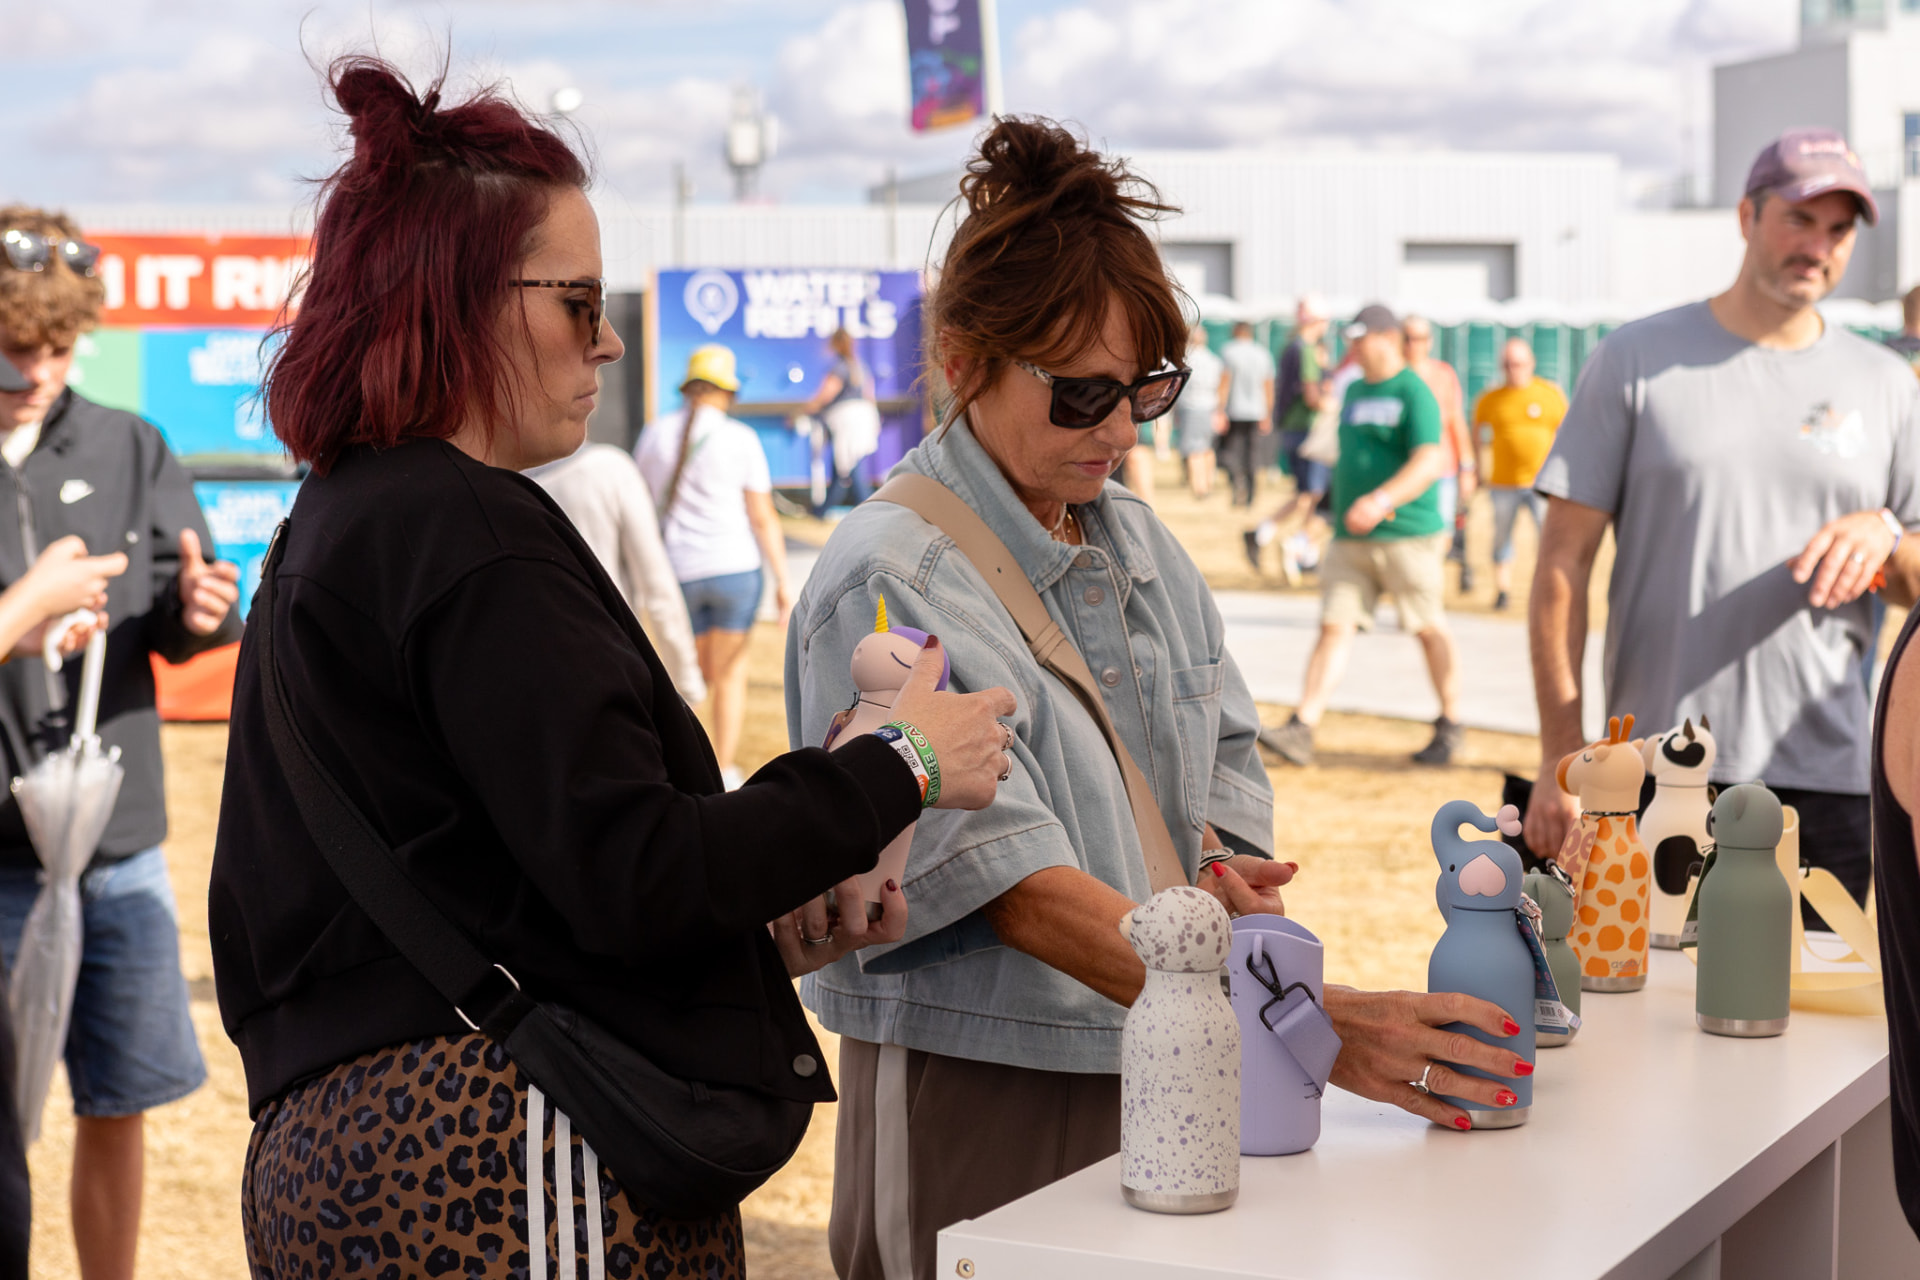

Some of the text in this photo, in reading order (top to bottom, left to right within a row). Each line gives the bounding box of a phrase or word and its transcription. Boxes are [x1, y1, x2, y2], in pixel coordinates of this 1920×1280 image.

[135, 254, 205, 310] IT
[742, 271, 882, 305] WATER
[743, 303, 898, 339] REFILLS
[925, 751, 939, 805] ATURE
